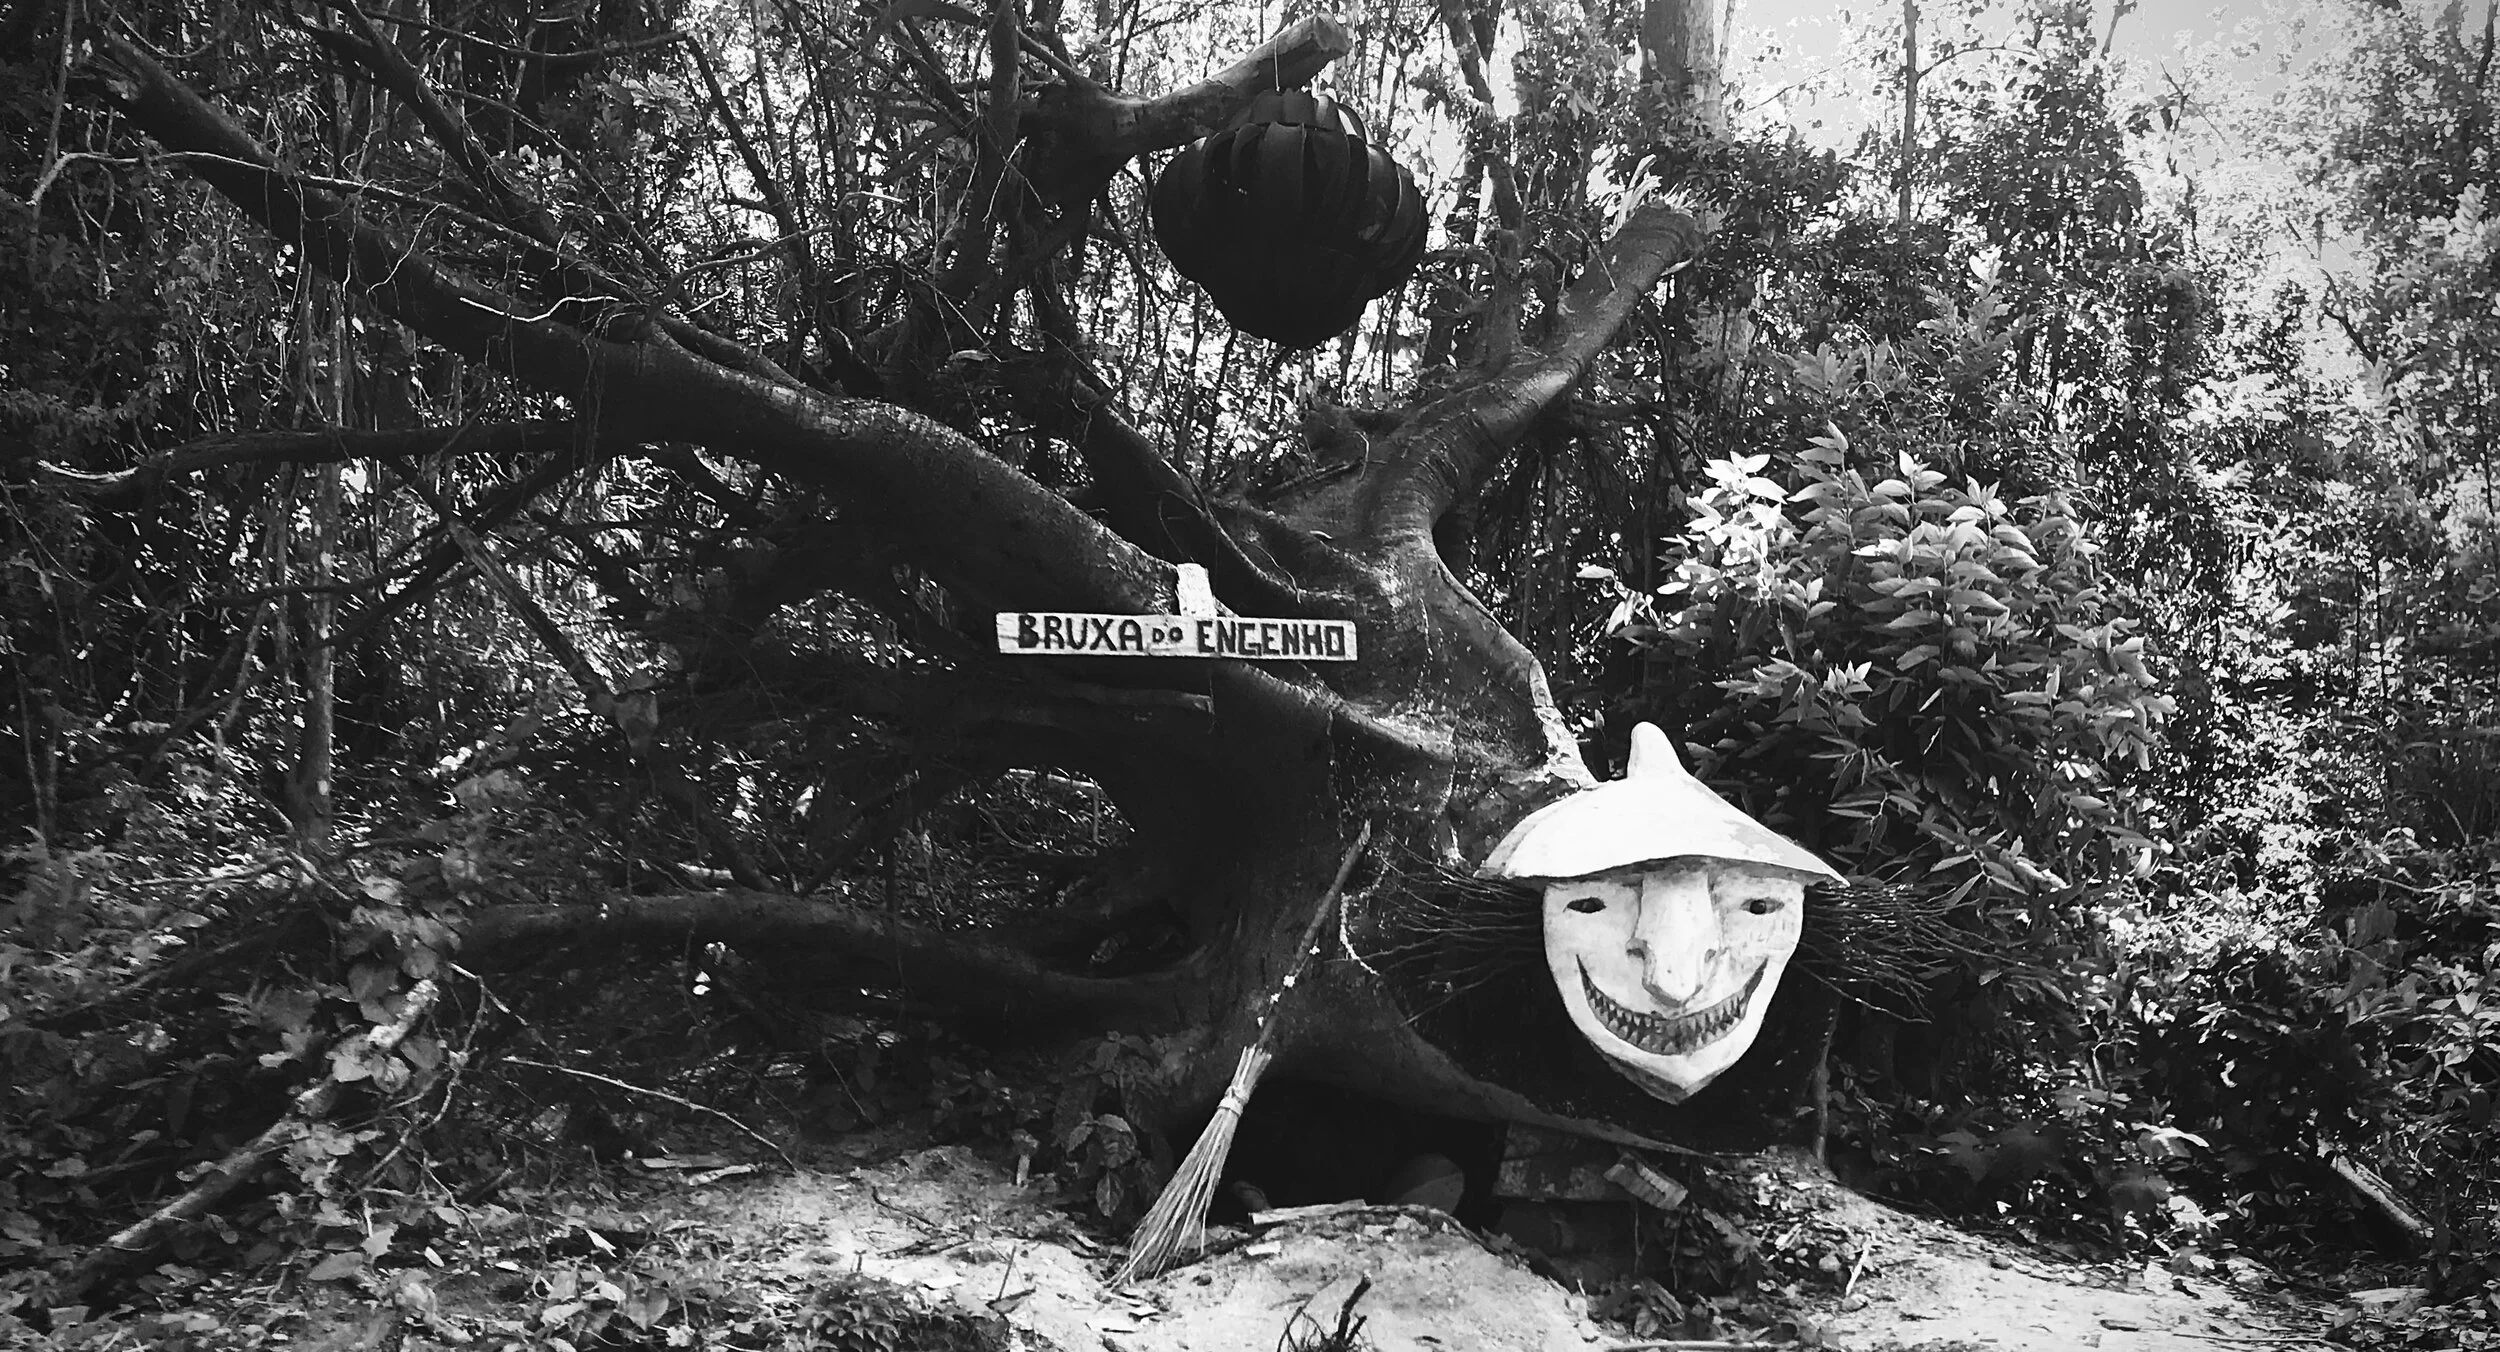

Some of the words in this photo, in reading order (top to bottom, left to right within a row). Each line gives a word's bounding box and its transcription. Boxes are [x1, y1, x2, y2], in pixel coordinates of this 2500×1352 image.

[1017, 613, 1143, 651] BRUXA
[1152, 626, 1183, 643] DO
[1196, 620, 1345, 657] ENGENHO
